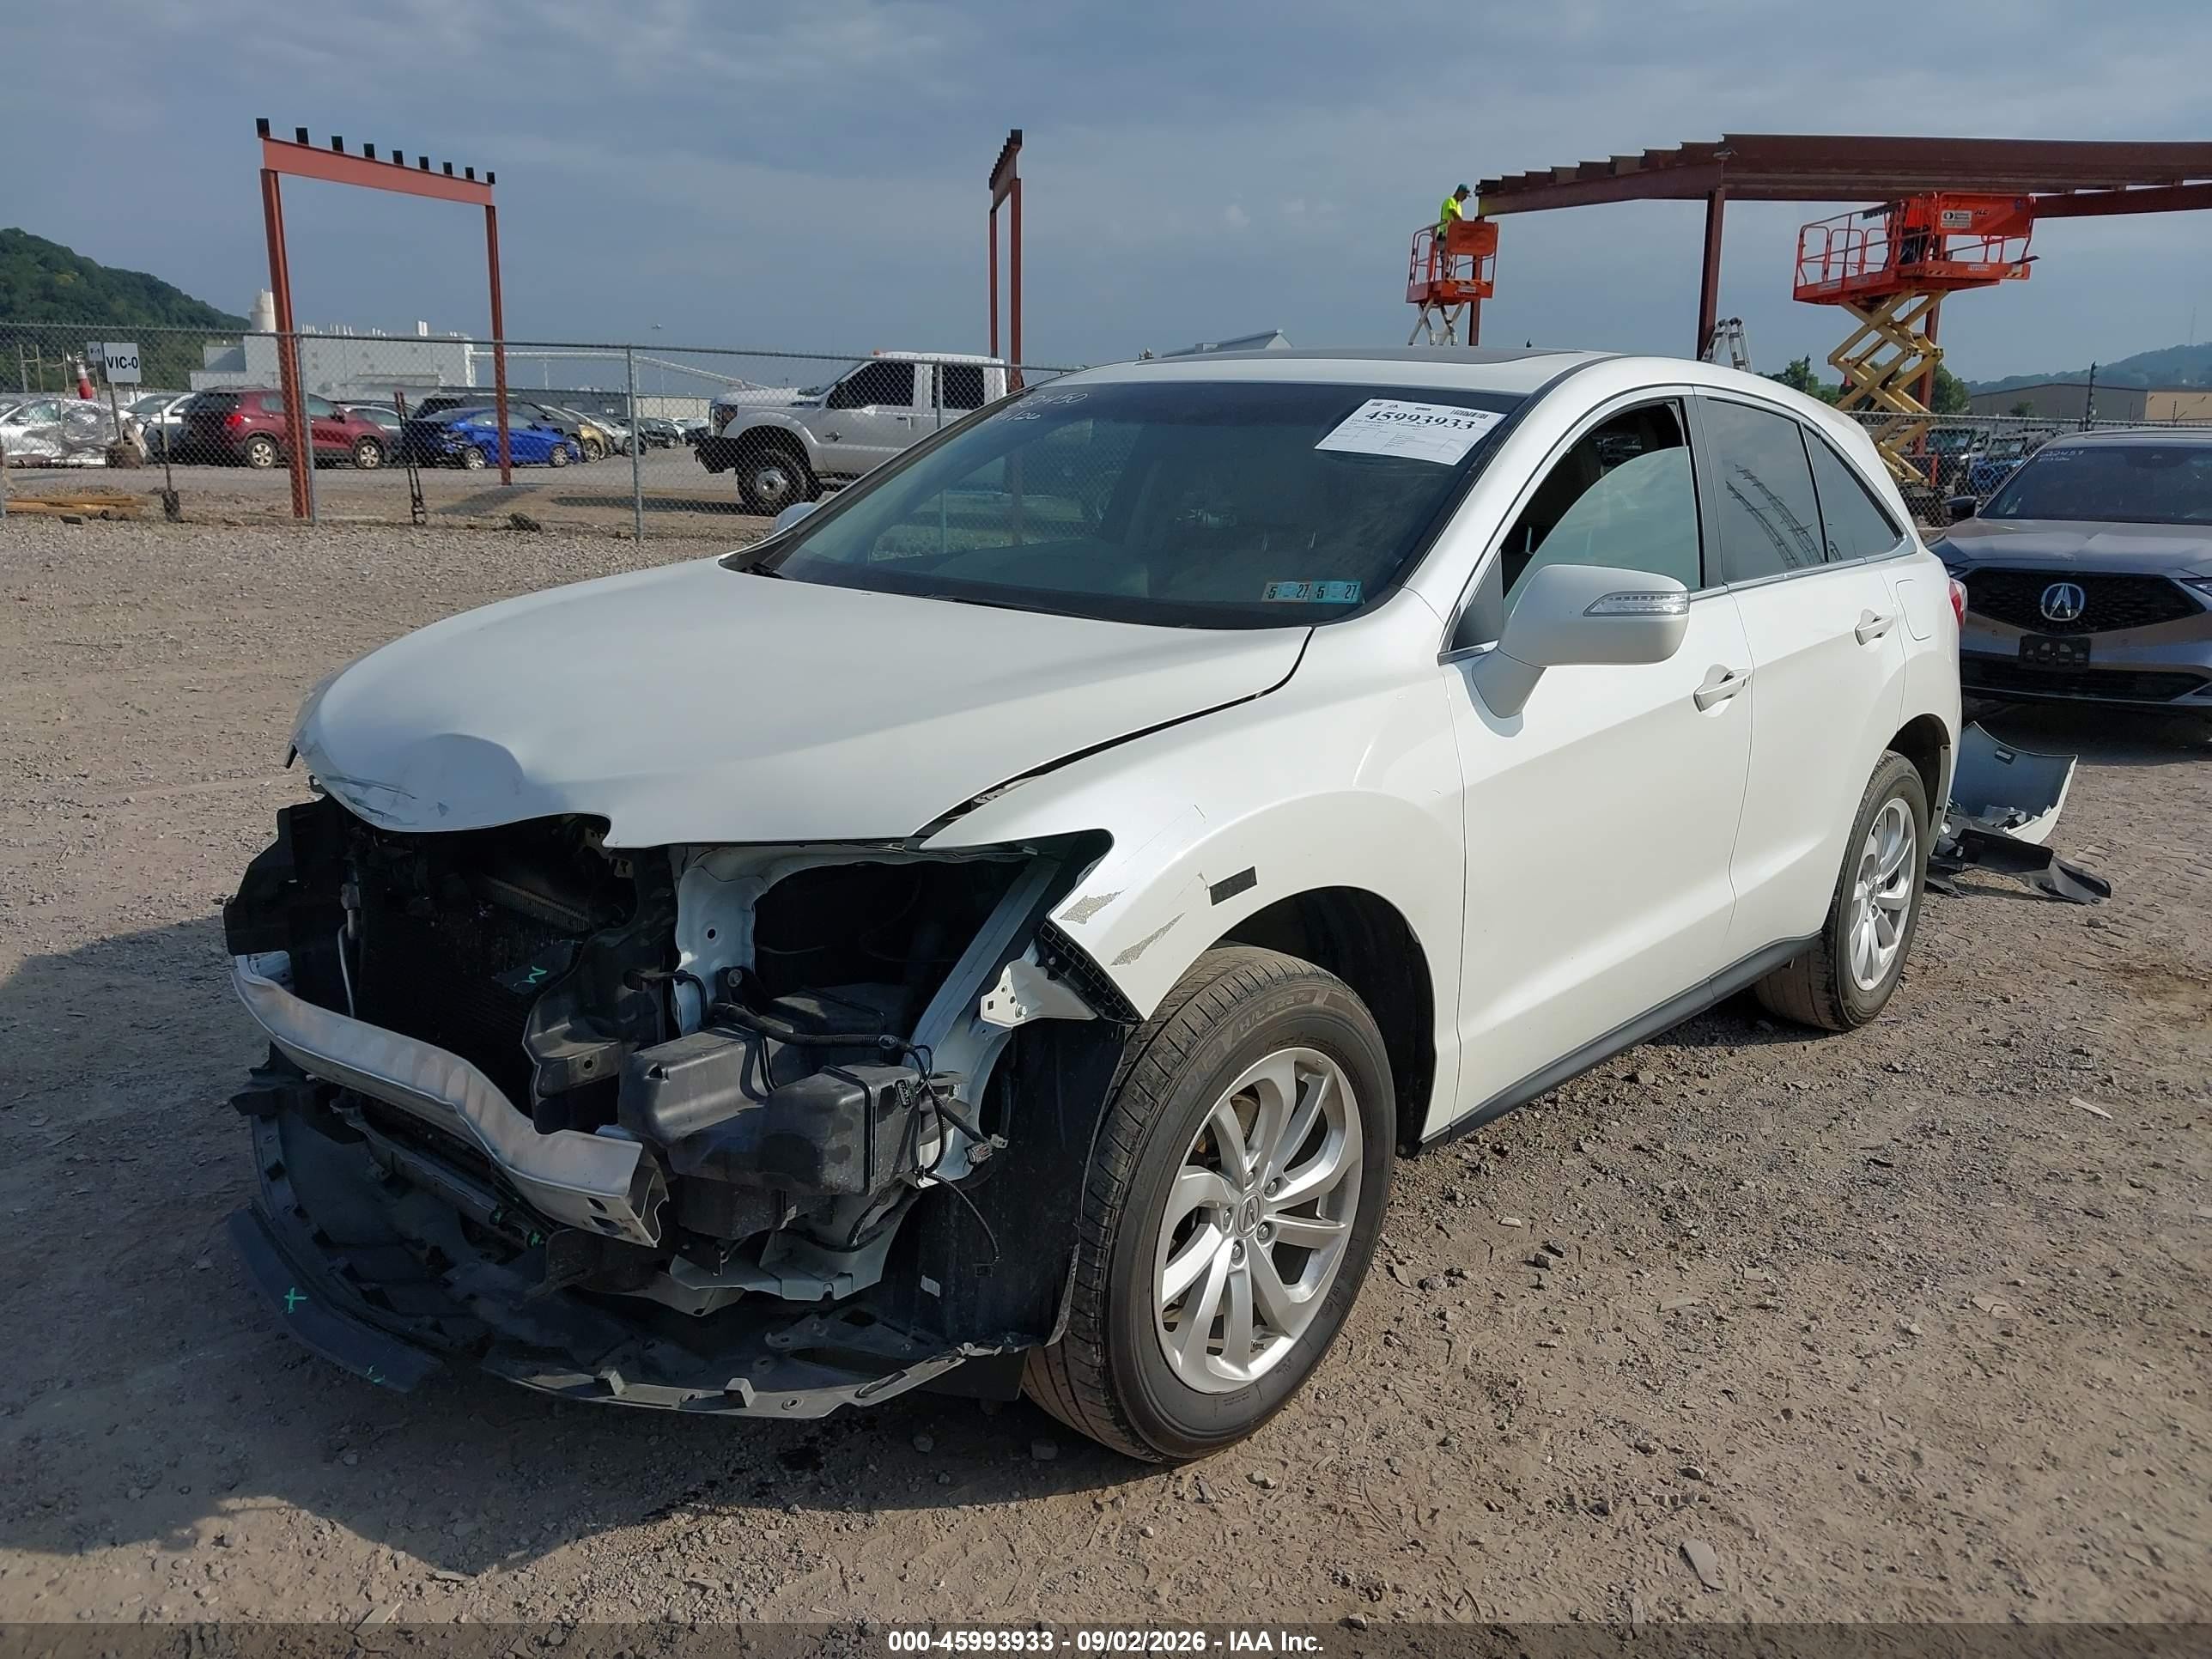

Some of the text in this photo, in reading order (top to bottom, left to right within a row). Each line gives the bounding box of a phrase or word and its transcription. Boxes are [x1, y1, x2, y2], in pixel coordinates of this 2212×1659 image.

[106, 356, 138, 369] VIC-0
[1365, 410, 1476, 430] 45993933
[1267, 584, 1310, 599] 5 27
[1316, 584, 1357, 599] 5 27
